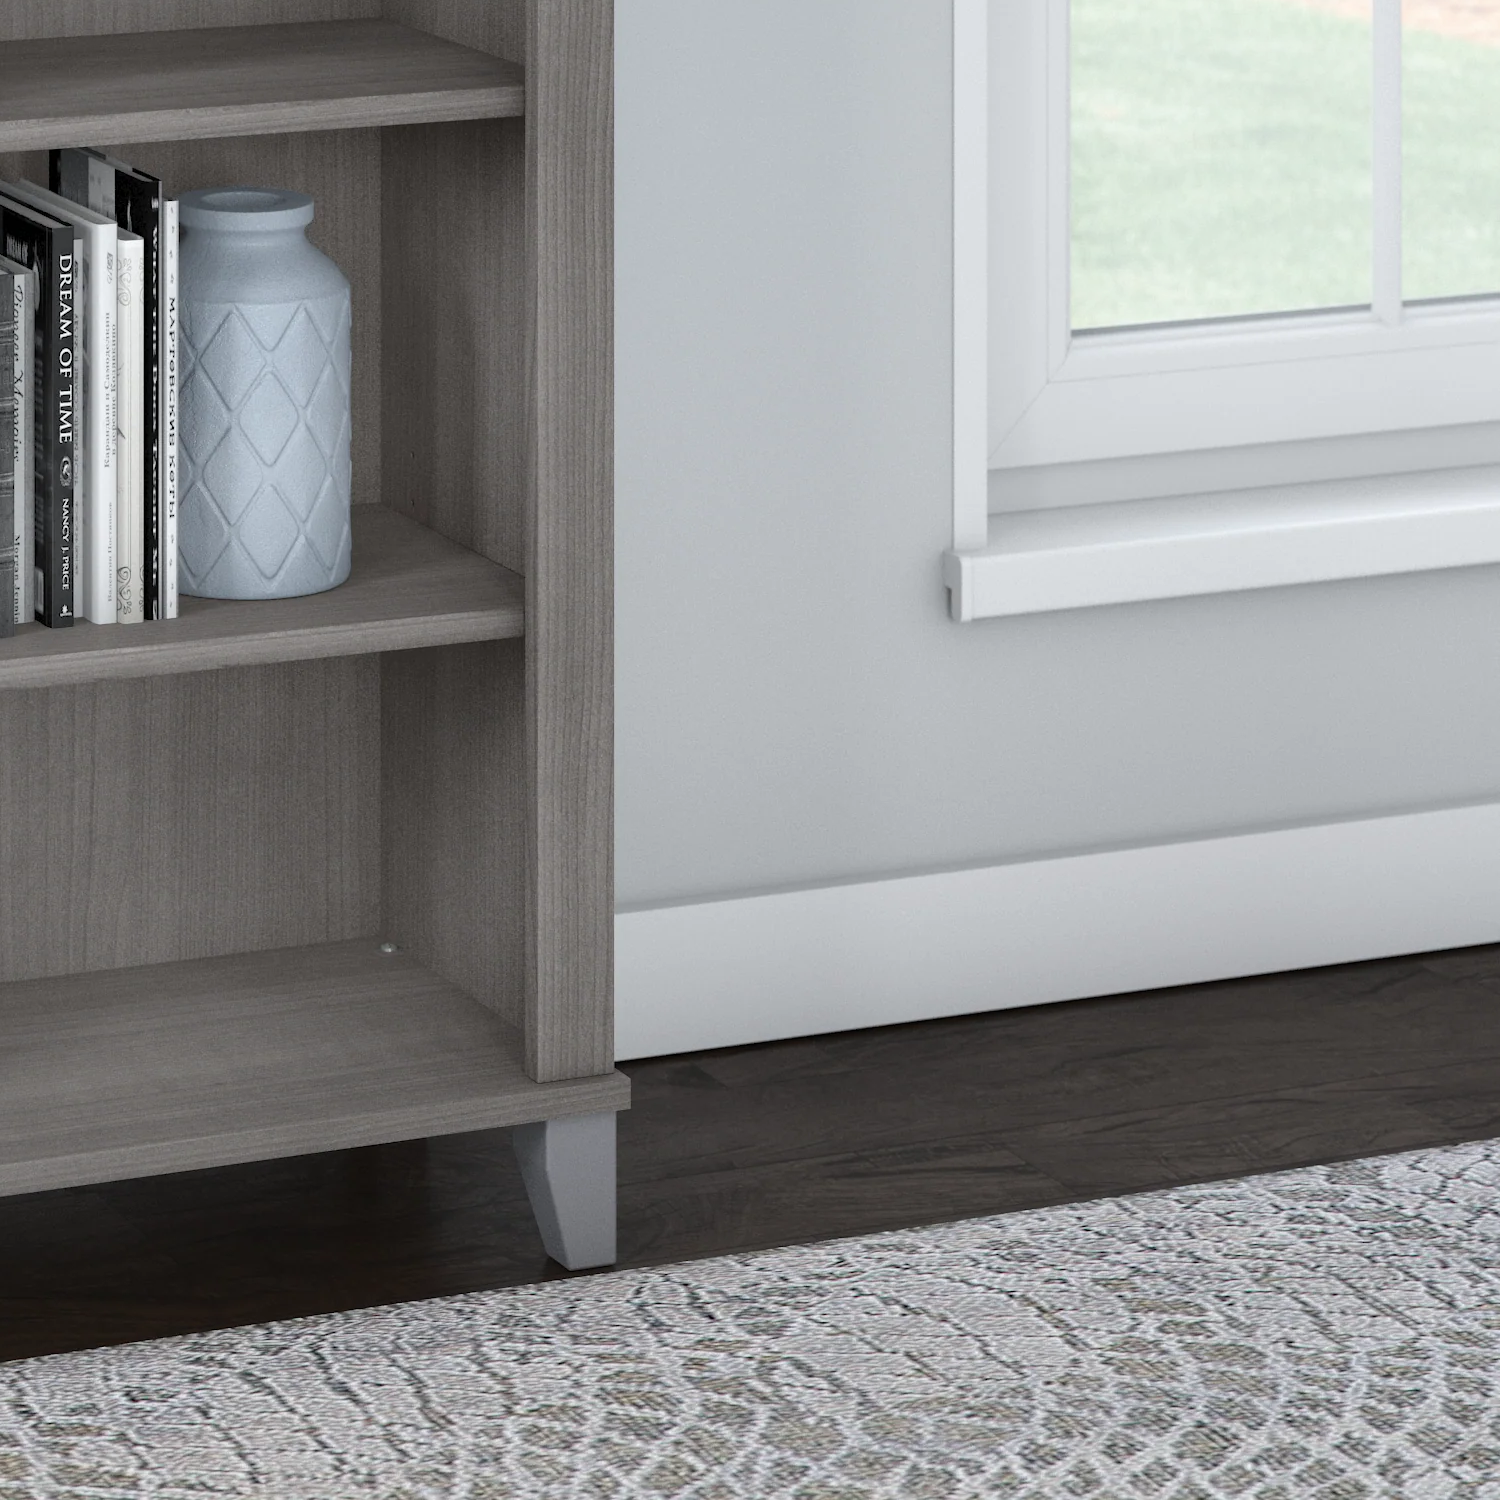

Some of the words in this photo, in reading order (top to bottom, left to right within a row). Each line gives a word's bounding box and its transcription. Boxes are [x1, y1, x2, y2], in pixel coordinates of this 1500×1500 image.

[59, 253, 73, 340] DREAM
[59, 347, 73, 378] OF
[59, 384, 73, 444] TIME
[61, 498, 71, 542] NANCY
[61, 556, 71, 590] PRICE
